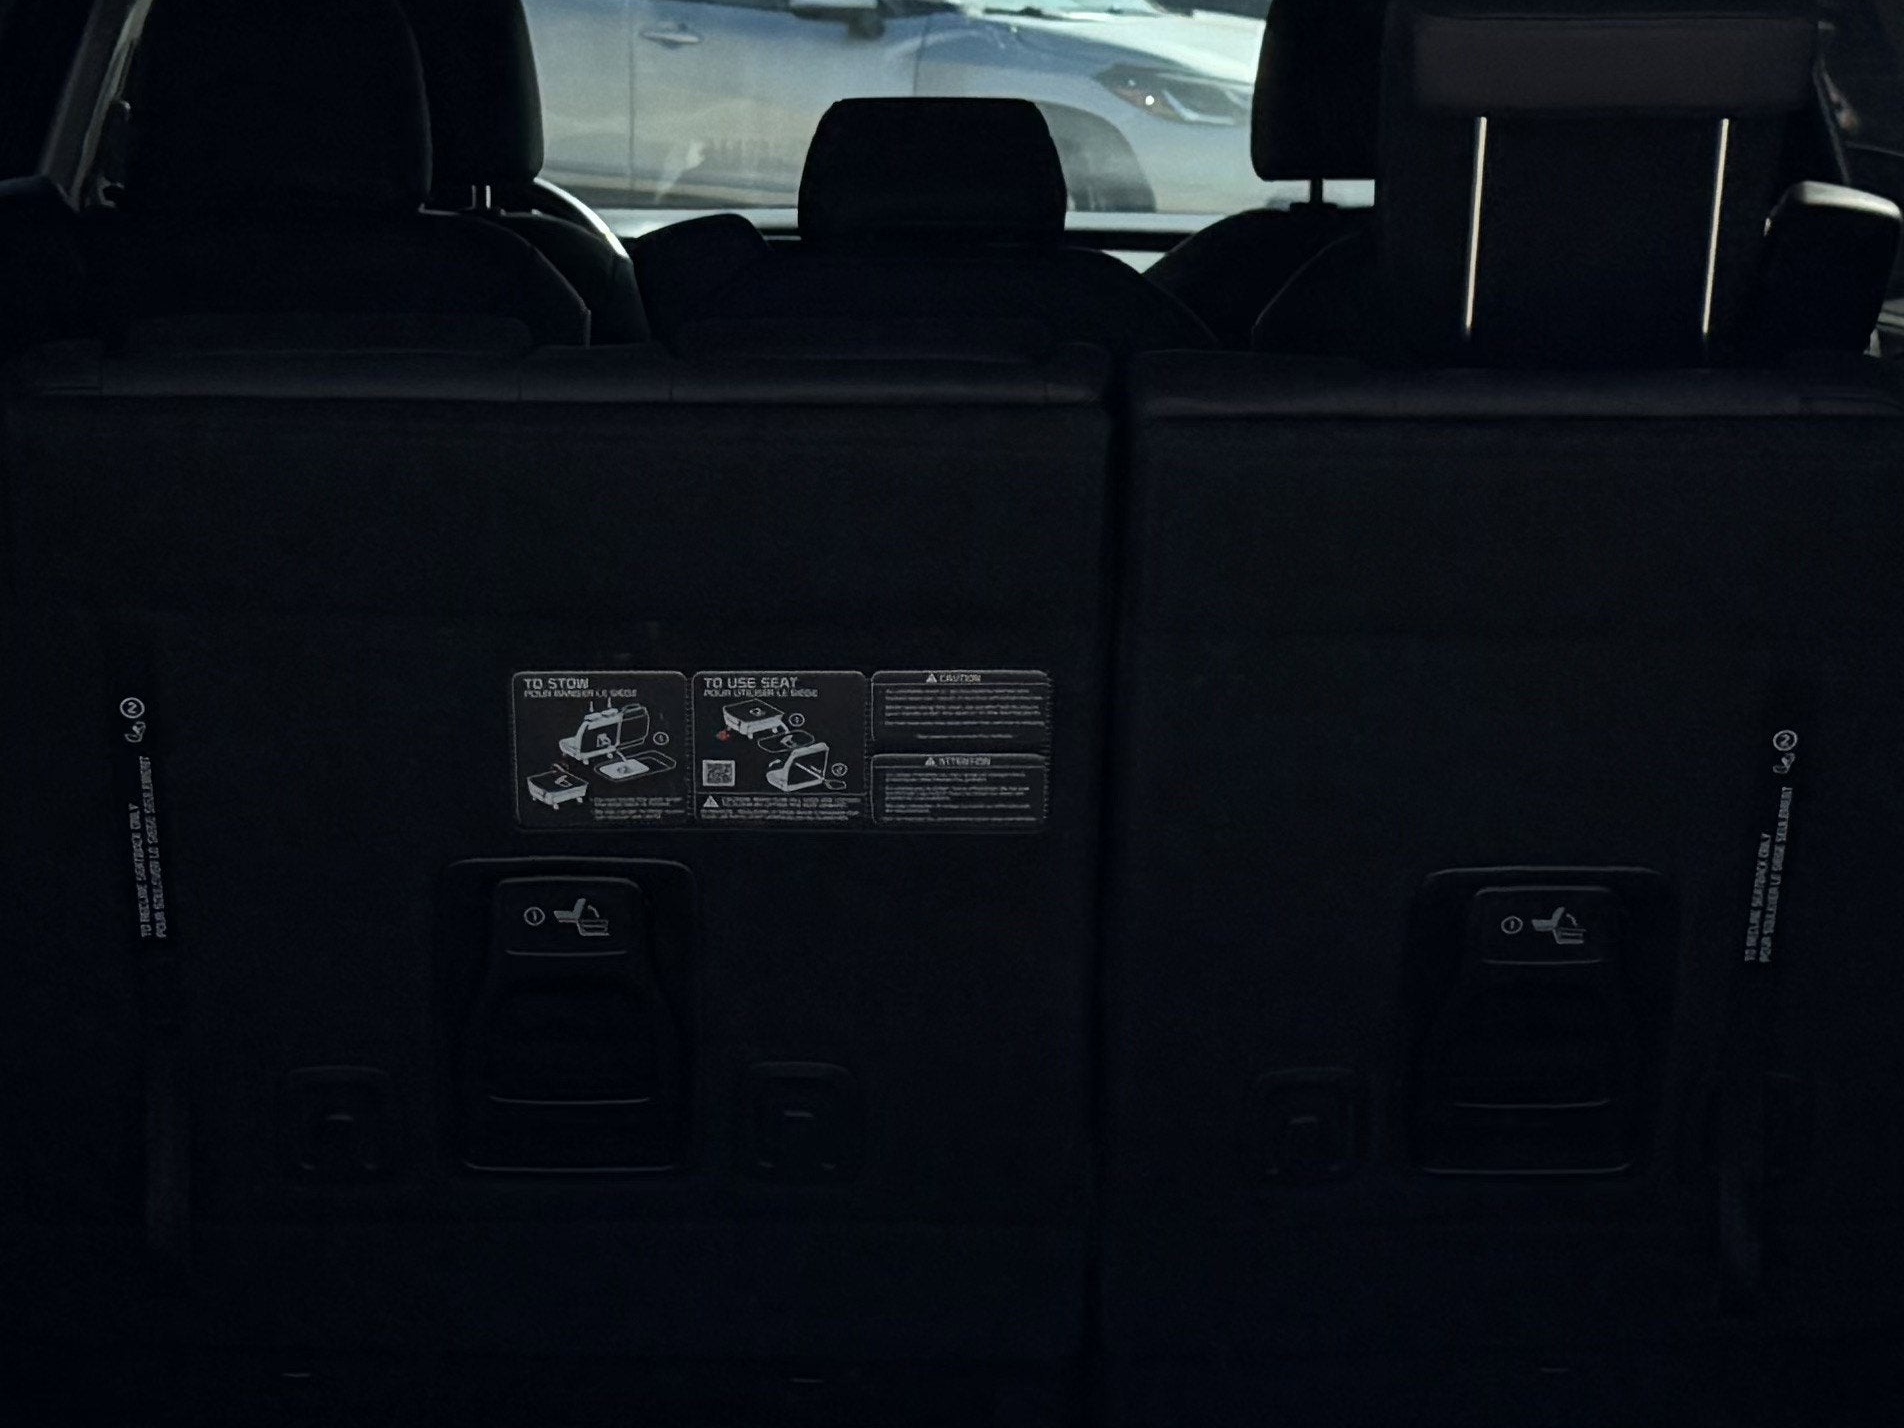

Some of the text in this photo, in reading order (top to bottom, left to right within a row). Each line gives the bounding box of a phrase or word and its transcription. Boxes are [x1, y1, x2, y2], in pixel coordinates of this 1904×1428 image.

[524, 677, 589, 689] TO STOW
[704, 676, 798, 689] TO USE SEAT
